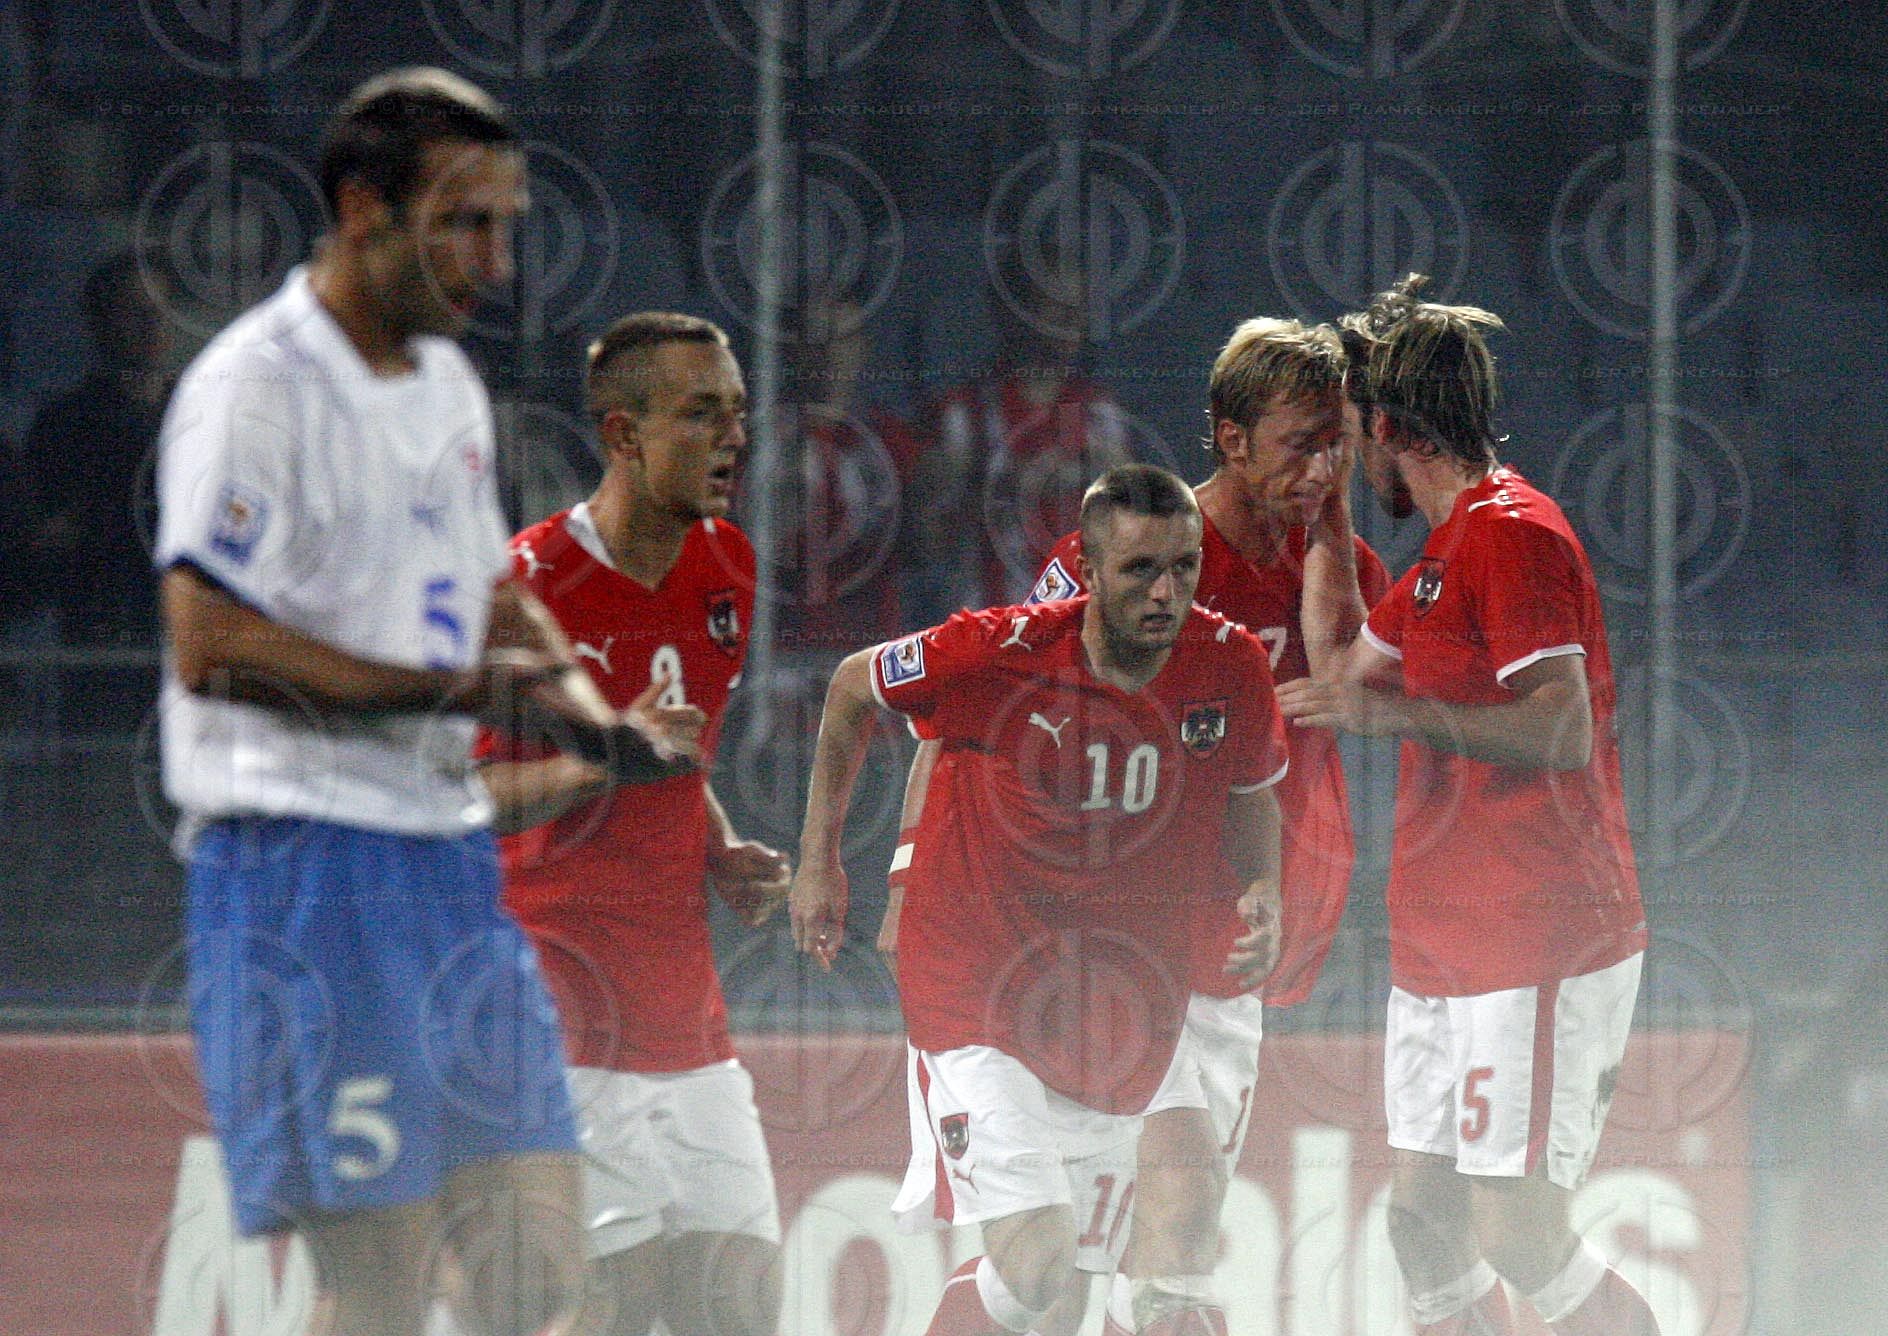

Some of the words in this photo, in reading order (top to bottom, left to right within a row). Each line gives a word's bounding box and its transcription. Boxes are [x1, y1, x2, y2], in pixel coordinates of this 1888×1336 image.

[425, 577, 464, 671] 5
[1259, 626, 1287, 672] 7
[650, 644, 686, 708] 8
[1081, 742, 1159, 813] 10
[328, 1076, 399, 1181] 5
[1460, 1066, 1494, 1142] 5
